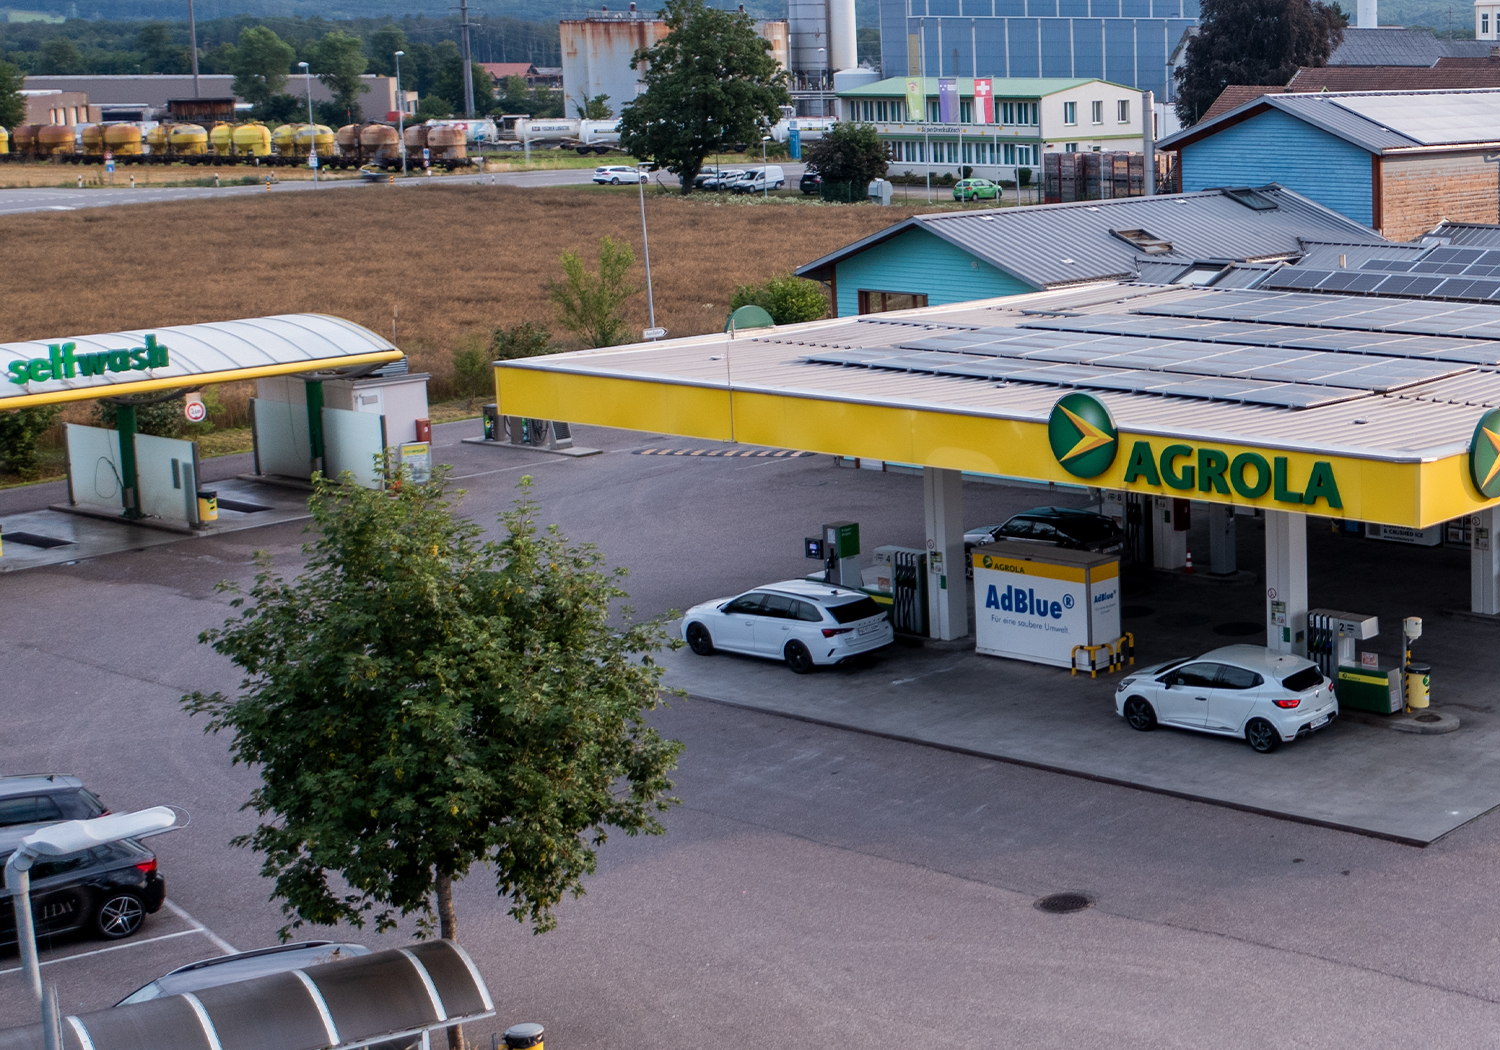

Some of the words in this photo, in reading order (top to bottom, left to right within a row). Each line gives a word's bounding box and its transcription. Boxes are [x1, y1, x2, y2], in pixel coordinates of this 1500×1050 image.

[8, 334, 169, 385] selfwash
[1123, 440, 1343, 509] AGROLA
[1388, 529, 1414, 537] CRUSHED
[885, 555, 891, 563] 4
[994, 563, 1025, 574] AGROLA
[991, 614, 1002, 623] Für
[1002, 616, 1017, 626] eine
[1018, 620, 1043, 630] saubere
[1339, 622, 1345, 632] 2
